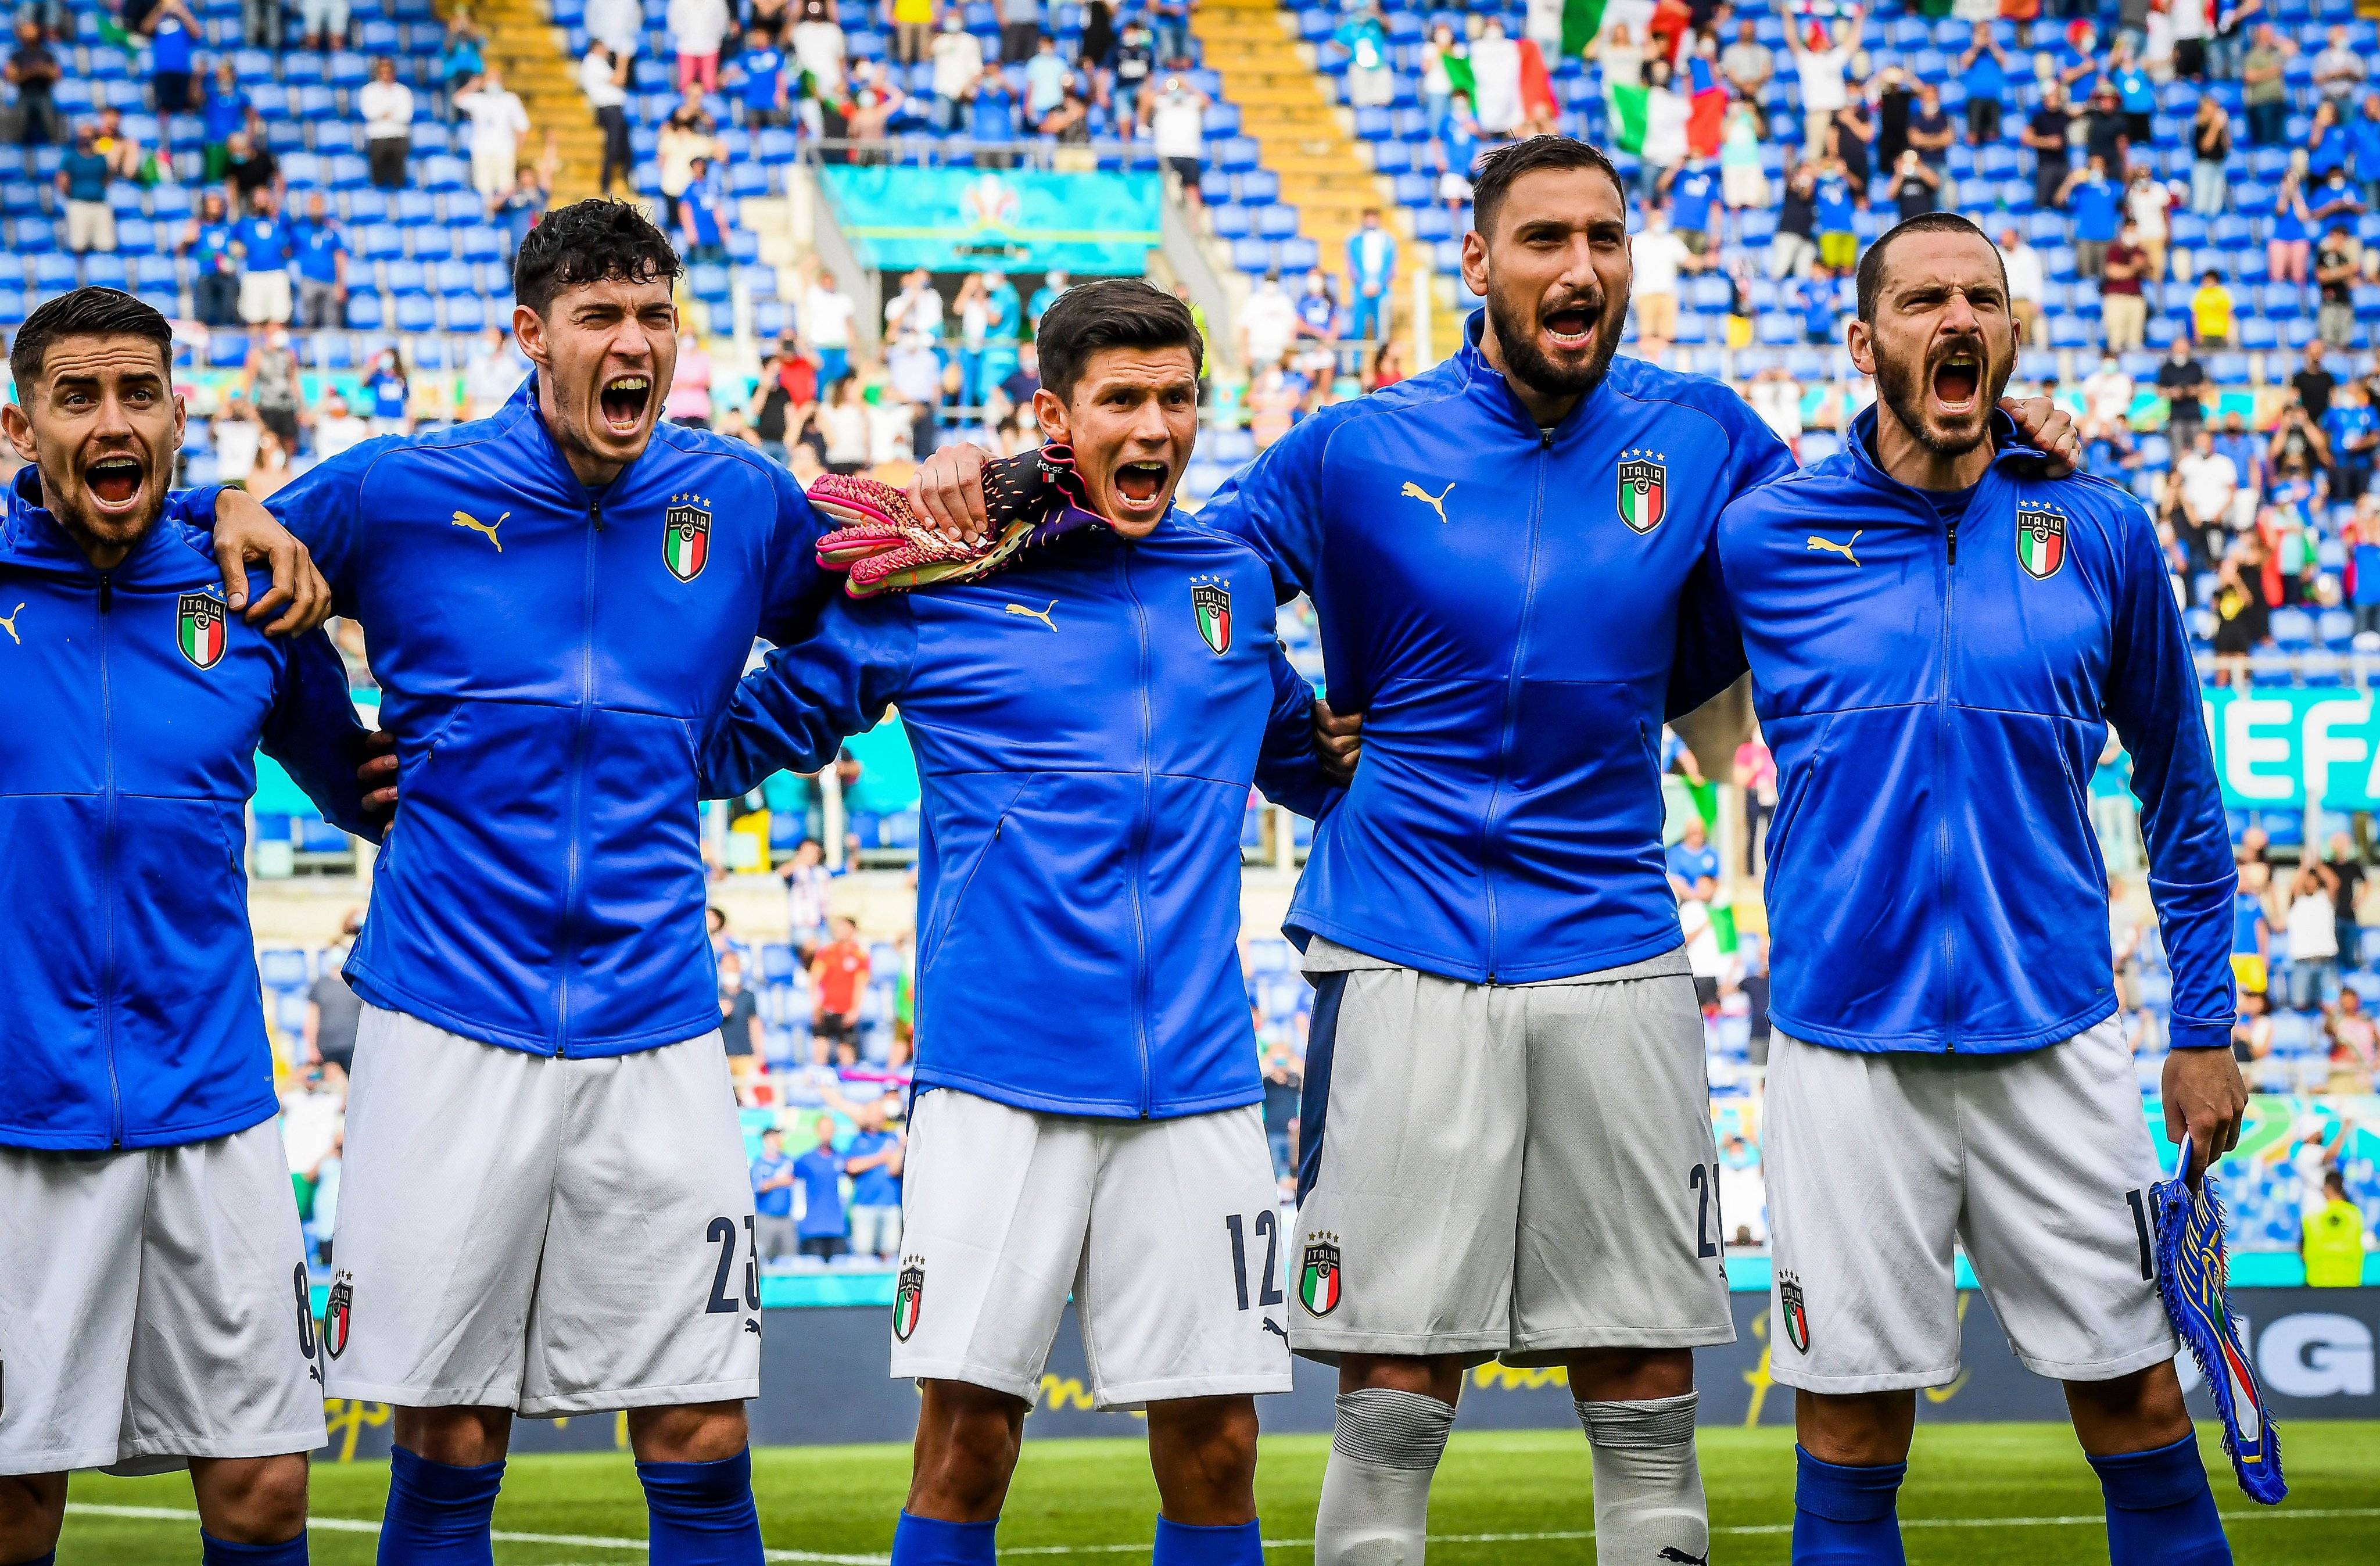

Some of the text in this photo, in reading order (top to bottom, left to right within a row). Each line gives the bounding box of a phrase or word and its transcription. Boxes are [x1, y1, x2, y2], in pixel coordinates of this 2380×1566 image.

[1622, 467, 1661, 481] ITALIA
[671, 512, 707, 527] ITALIA
[2021, 515, 2062, 531] ITALIA
[1195, 591, 1227, 606] ITALIA
[182, 600, 221, 616] ITALIA
[2202, 700, 2380, 799] EF
[1226, 1210, 1283, 1311] 12
[1308, 1249, 1338, 1262] ITALIA
[705, 1214, 761, 1314] 23
[901, 1273, 922, 1285] ITALIA
[332, 1288, 349, 1300] LIA
[1782, 1287, 1801, 1302] ITALIA
[293, 1262, 316, 1360] 8
